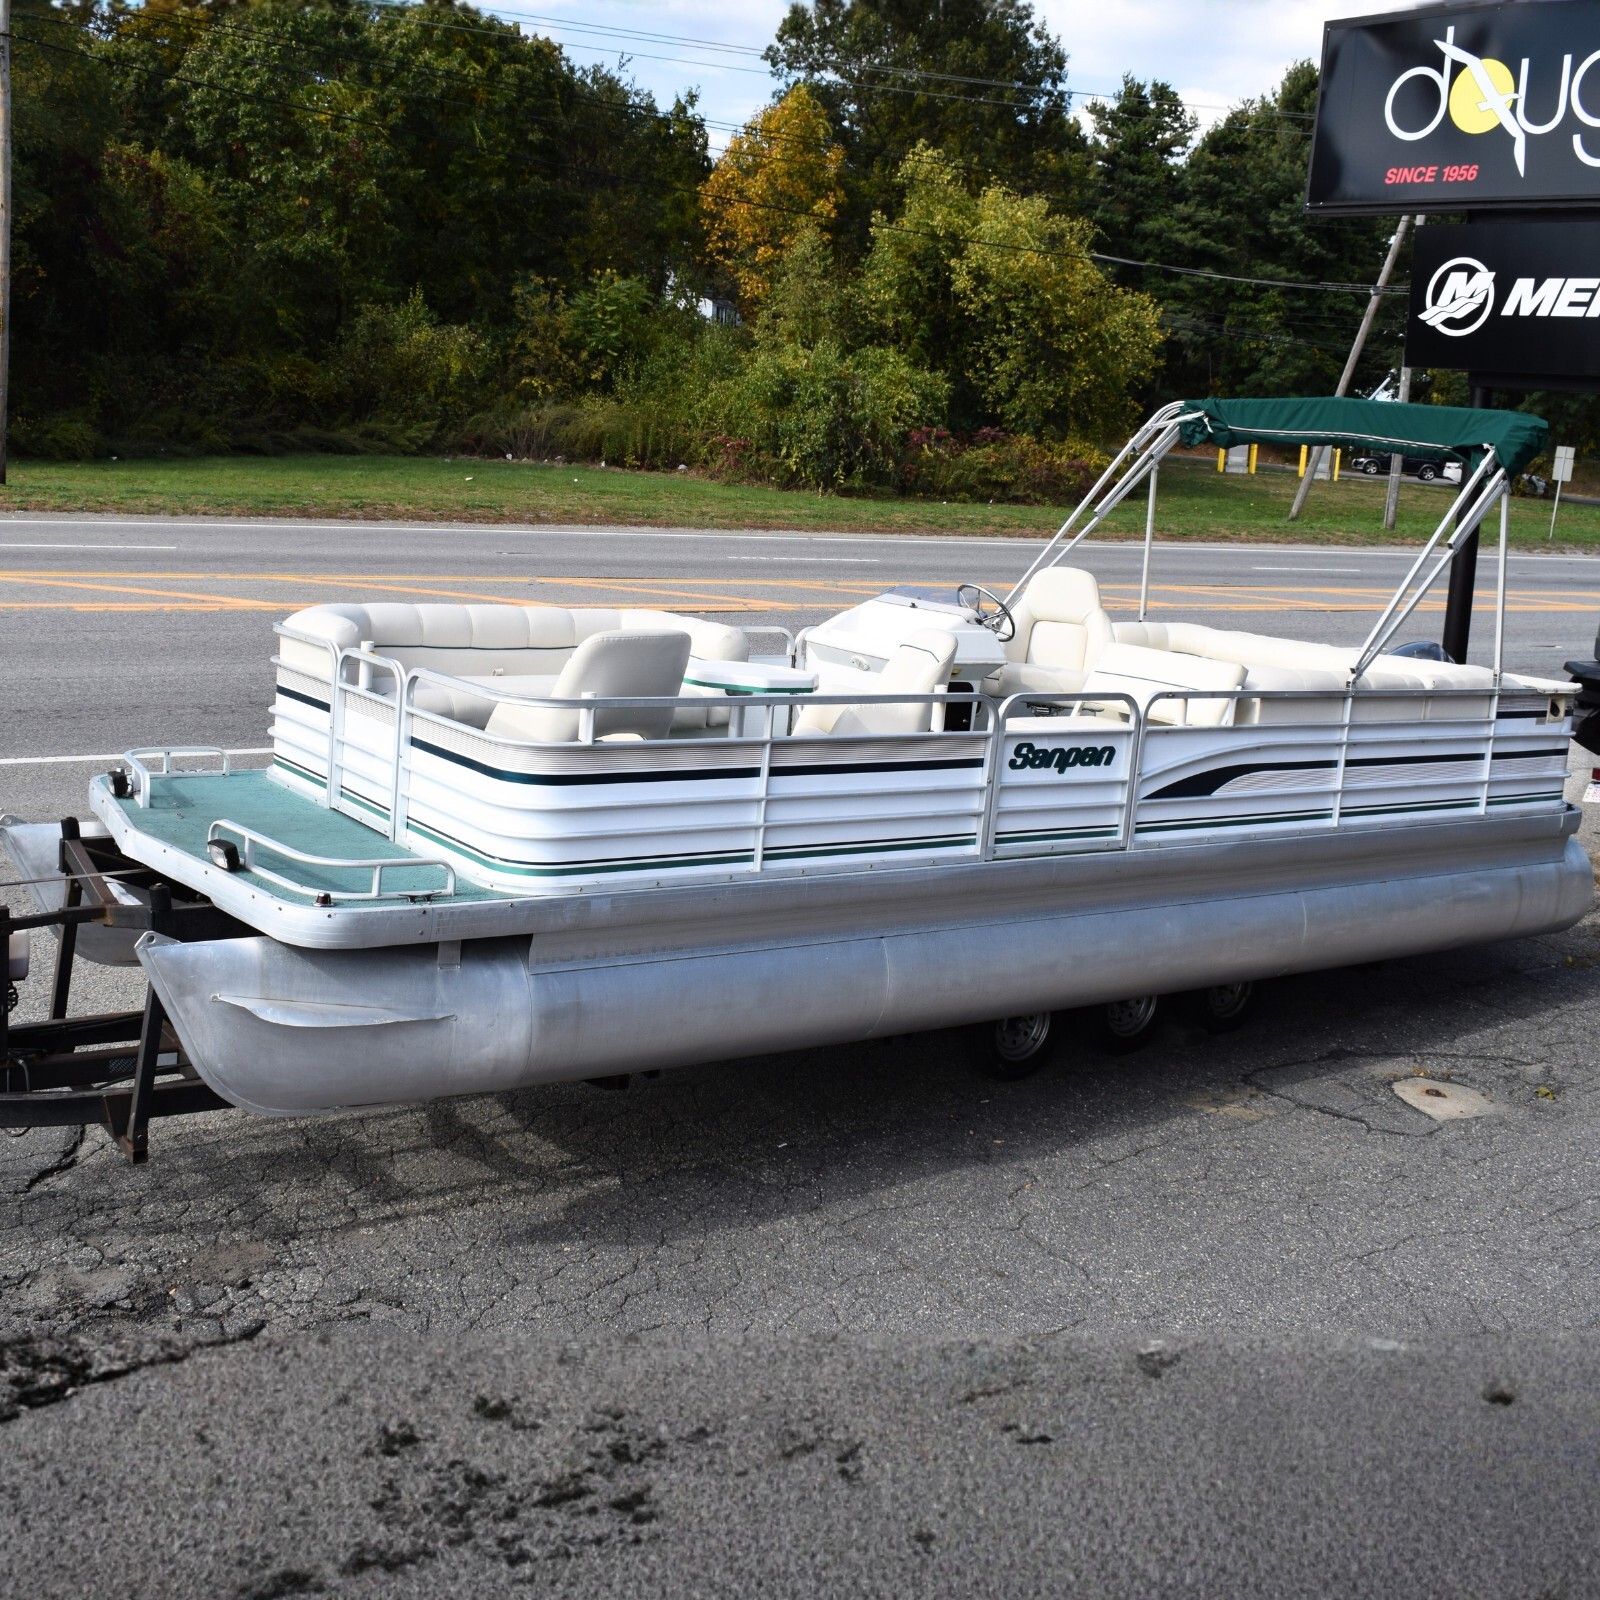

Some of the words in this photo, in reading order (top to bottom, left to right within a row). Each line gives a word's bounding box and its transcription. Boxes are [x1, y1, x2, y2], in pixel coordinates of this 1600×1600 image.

[1385, 166, 1438, 184] SINCE
[1442, 165, 1479, 182] 1956
[1009, 742, 1116, 774] Sanpan
